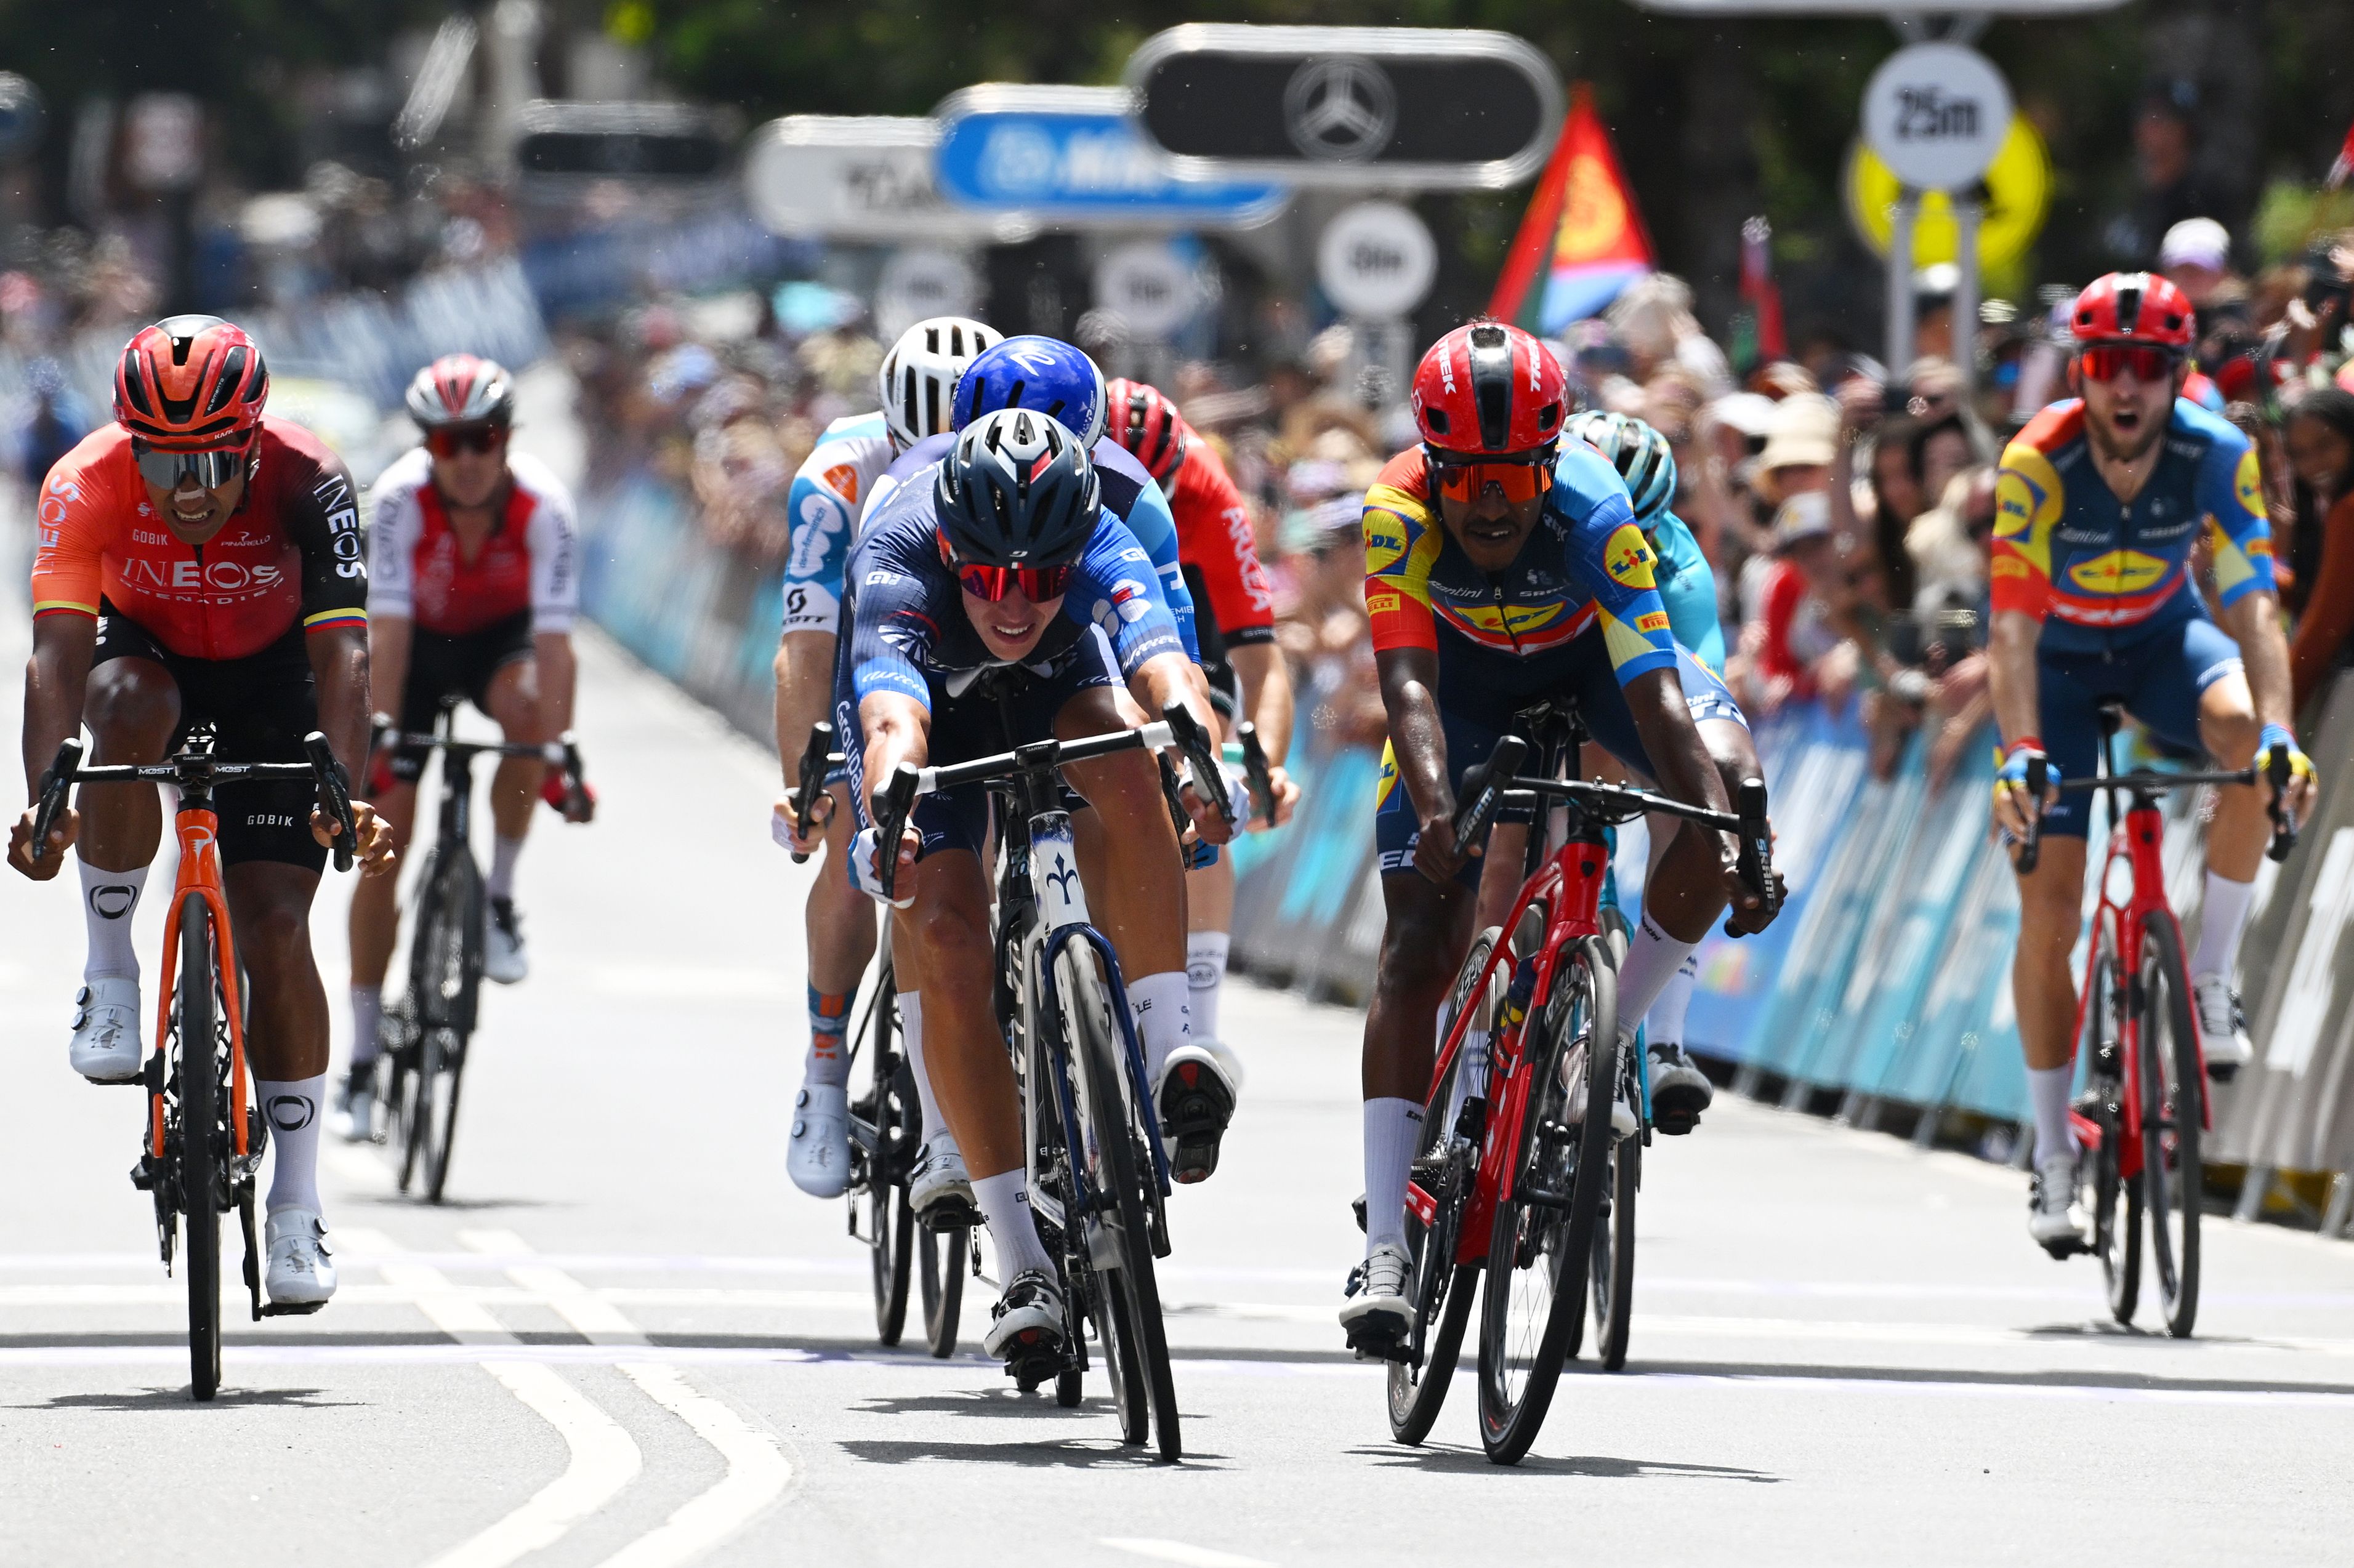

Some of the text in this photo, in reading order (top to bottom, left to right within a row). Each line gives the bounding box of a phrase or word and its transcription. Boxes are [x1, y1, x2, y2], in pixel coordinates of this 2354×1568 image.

[1895, 85, 1978, 141] 25m
[1438, 340, 1456, 394] TREK
[1526, 336, 1541, 392] TREK
[214, 428, 234, 440] KASK
[31, 475, 80, 577] INEOS
[132, 528, 168, 545] GOBIK
[220, 534, 270, 547] PINARELLO
[313, 473, 368, 580] INEOS
[121, 558, 280, 589] INEOS
[1171, 605, 1195, 616] EMIER
[1367, 601, 1393, 611] ELLI
[1641, 616, 1669, 629] PIRE
[247, 814, 293, 827] GOBIK
[1457, 786, 1496, 844] SRAM
[1755, 837, 1776, 899] SRAM
[1641, 915, 1662, 943] antini
